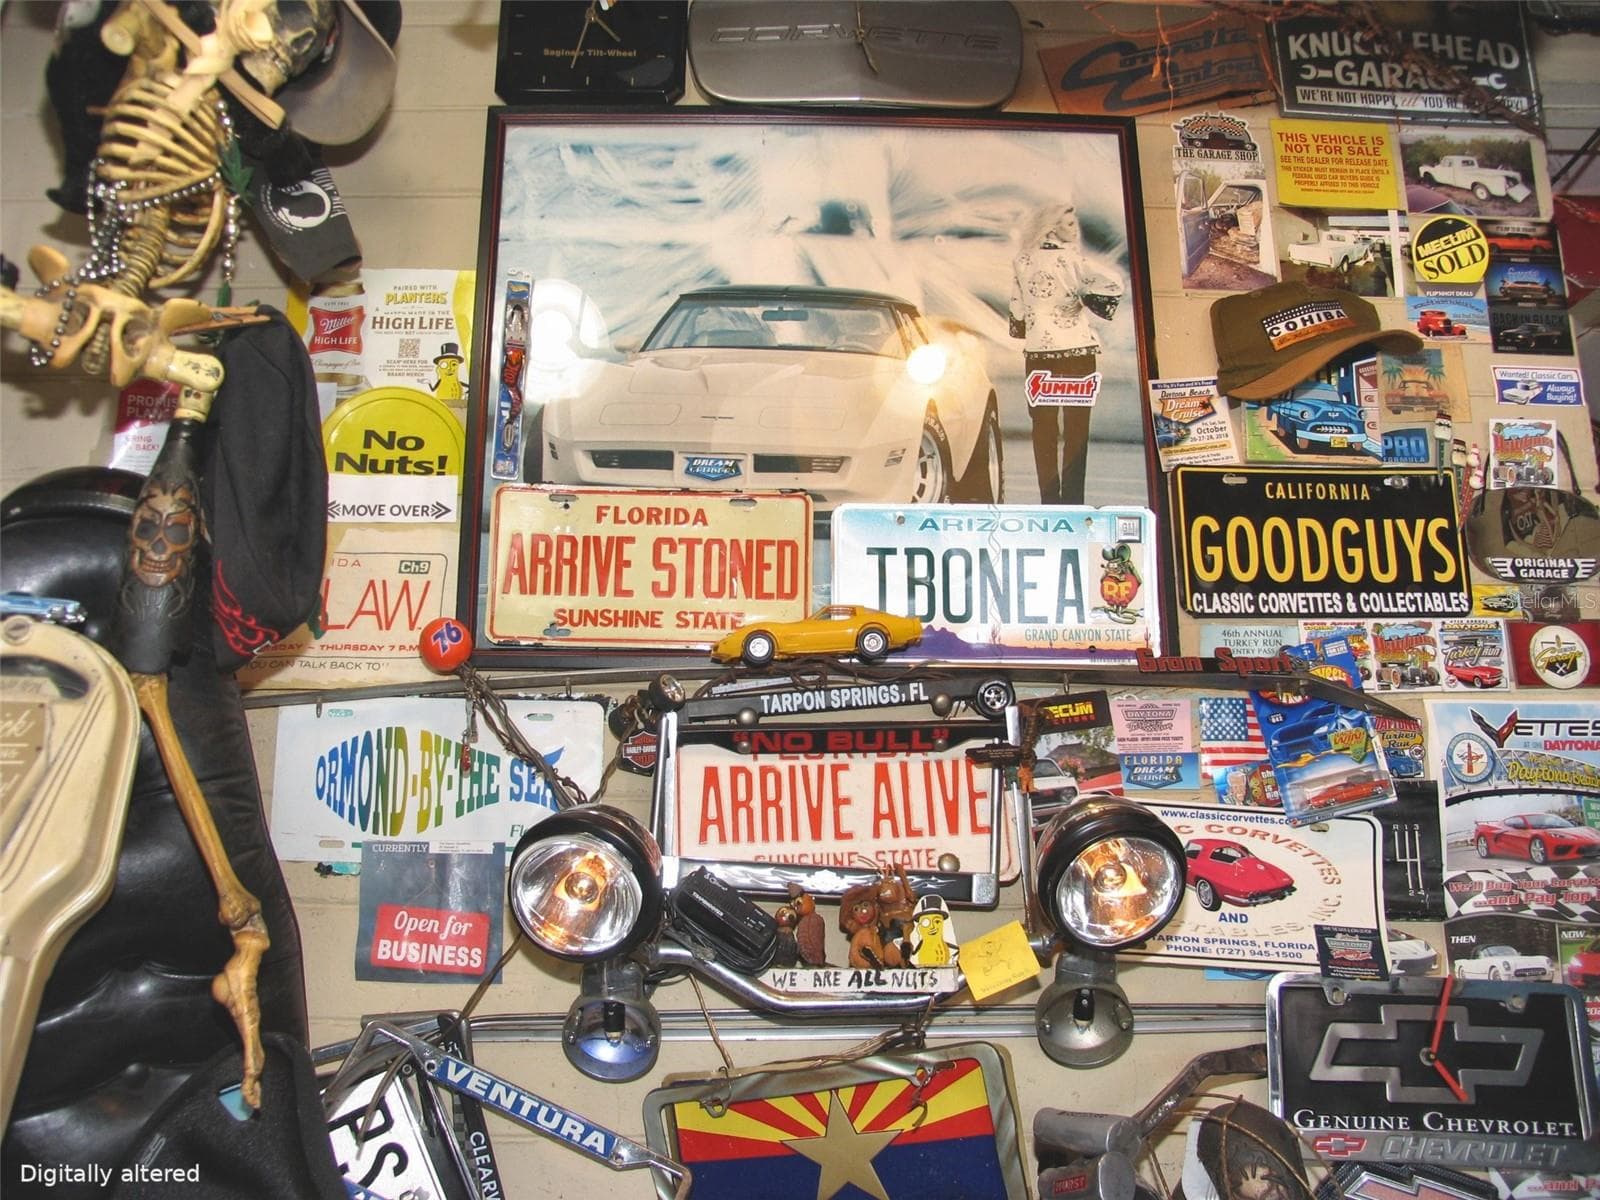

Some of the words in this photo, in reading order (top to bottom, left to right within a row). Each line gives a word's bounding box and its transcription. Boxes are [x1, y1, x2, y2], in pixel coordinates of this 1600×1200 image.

[586, 49, 637, 57] Tilt-Wheel
[1299, 88, 1334, 103] WE'RE
[1336, 91, 1359, 105] NOT
[1360, 92, 1399, 108] HAPPY,
[1277, 132, 1308, 143] THIS
[1312, 134, 1367, 145] VEHICLE
[1371, 136, 1385, 146] IS
[1177, 149, 1195, 159] THE
[1197, 150, 1232, 161] GARAGE
[1234, 152, 1259, 162] SHOP
[1284, 143, 1310, 154] NOT
[1315, 144, 1343, 155] FOR
[1347, 146, 1382, 157] SALE
[1280, 155, 1292, 163] SEE
[1293, 156, 1305, 164] THE
[1306, 156, 1330, 165] DEALER
[1331, 157, 1344, 166] FOR
[1345, 158, 1371, 166] RELEASE
[1373, 159, 1389, 167] DATE
[1423, 243, 1487, 281] SOLD
[384, 291, 448, 306] PLANTERS
[319, 316, 357, 335] Miller
[371, 316, 414, 330] HIGH
[418, 316, 455, 330] LIFE
[1268, 309, 1346, 338] COHIBA
[314, 335, 338, 345] HIGH
[339, 336, 358, 345] LIFE
[1499, 370, 1530, 379] Wanted!
[1531, 370, 1557, 380] Classic
[1557, 372, 1574, 380] Cars
[1189, 387, 1211, 397] Beach
[1546, 384, 1575, 394] Always
[1546, 392, 1577, 403] Buying!
[1167, 399, 1201, 412] Dream
[1171, 408, 1205, 419] Cruise
[1196, 425, 1227, 435] October
[363, 429, 425, 451] No
[1381, 435, 1427, 457] PRO
[334, 452, 448, 476] Nuts!
[692, 458, 735, 467] DREAM
[1265, 481, 1371, 501] CALIFORNIA
[341, 504, 386, 517] MOVE
[389, 504, 430, 517] OVER
[596, 505, 709, 527] FLORIDA
[918, 516, 1075, 534] ARIZONA
[1190, 515, 1457, 583] GOODGUYS
[400, 561, 430, 574] Ch9
[502, 533, 637, 598] ARRIVE
[651, 537, 800, 602] STONED
[1514, 558, 1575, 568] ORIGINAL
[1519, 568, 1570, 579] GARAGE
[866, 547, 1086, 625] TBONEA
[1102, 580, 1133, 598] RF
[319, 578, 432, 632] LAW
[1192, 592, 1255, 614] CLASSIC
[1259, 592, 1344, 614] CORVETTES
[1346, 592, 1358, 613] &
[1359, 591, 1469, 613] COLLECTABLES
[553, 608, 664, 629] SUNSHINE
[675, 610, 746, 631] STATE
[1221, 629, 1241, 638] 46th
[1243, 629, 1283, 638] ANNUAL
[1443, 623, 1497, 631] DAYTONA
[432, 621, 464, 655] 76
[1024, 629, 1060, 642] GRAND
[1062, 629, 1102, 642] CANYON
[1104, 629, 1133, 642] STATE
[1223, 638, 1259, 647] TURKEY
[1262, 639, 1283, 647] RUN
[320, 644, 385, 652] THURSDAY
[1256, 647, 1276, 655] PASS
[1442, 645, 1482, 665] Turkey
[1481, 648, 1501, 657] RUN
[268, 660, 296, 669] CAN
[300, 660, 328, 670] TALK
[330, 660, 363, 670] BACK
[1135, 647, 1204, 673] Gran
[1213, 646, 1293, 678] Sport
[761, 689, 827, 715] TARPON
[831, 684, 906, 710] SPRINGS,
[909, 682, 929, 702] FL
[1126, 710, 1172, 718] DAYTONA
[1469, 707, 1600, 749] VETTES
[1380, 731, 1417, 741] Turkey
[1388, 739, 1410, 749] Run
[1124, 755, 1184, 766] FLORIDA
[1133, 766, 1176, 774] DREAM
[698, 763, 853, 846] ARRIVE
[872, 760, 992, 839] ALIVE
[371, 843, 428, 853] CURRENTLY
[1204, 823, 1342, 886] CORVETTES
[1408, 889, 1415, 897] 2
[1487, 881, 1513, 892] Buy
[1517, 880, 1546, 890] Your
[1523, 893, 1558, 906] Pay
[1563, 892, 1592, 905] Top
[1218, 912, 1249, 924] AND
[394, 910, 440, 936] Open
[440, 915, 473, 941] for
[1450, 935, 1477, 944] THEN
[1560, 930, 1586, 939] NOW
[1151, 934, 1200, 945] TARPON
[1203, 936, 1261, 949] SPRINGS,
[1264, 940, 1315, 951] FLORIDA
[377, 939, 483, 969] BUSINESS
[1166, 944, 1213, 955] PHONE:
[1216, 946, 1247, 958] (727)
[1249, 949, 1303, 960] 945-1500
[772, 970, 799, 988] WE
[812, 970, 842, 988] ARE
[847, 969, 888, 987] ALL
[890, 971, 939, 990] NUTS
[447, 1061, 607, 1155] VENTURA
[1380, 1136, 1567, 1167] CHEVROLET
